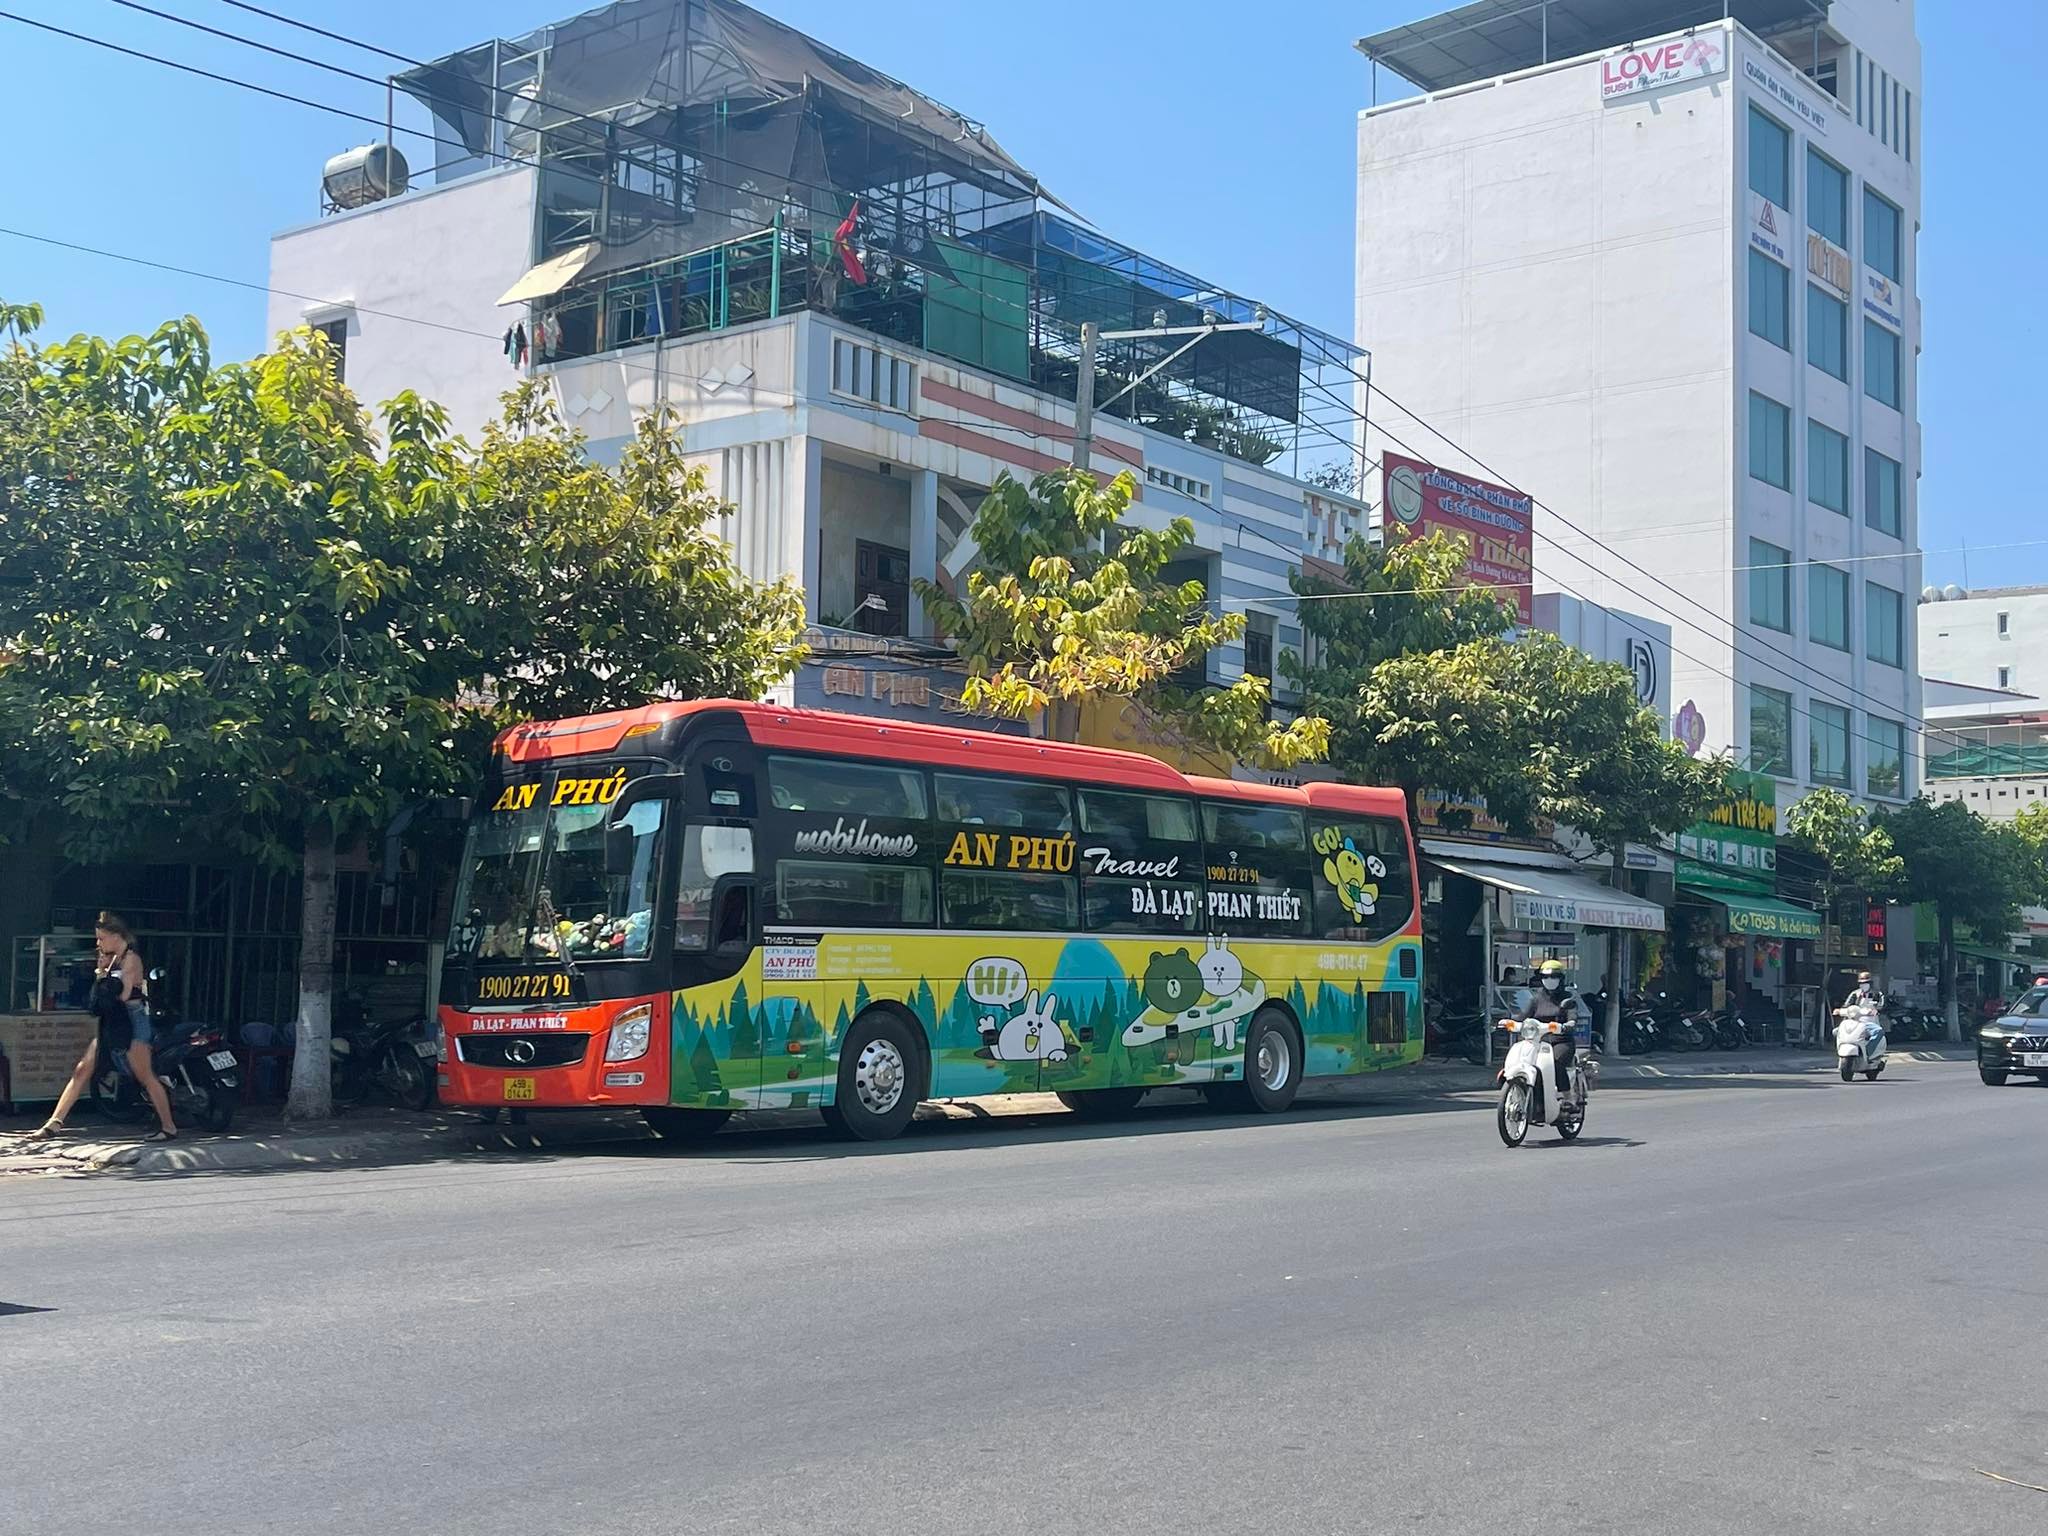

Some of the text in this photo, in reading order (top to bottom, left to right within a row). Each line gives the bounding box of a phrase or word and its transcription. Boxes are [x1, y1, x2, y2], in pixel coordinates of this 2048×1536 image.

[1603, 43, 1684, 85] LOVE
[1604, 80, 1633, 95] SUSHI
[491, 767, 627, 811] AN PHÚ
[795, 816, 918, 858] mobihome
[944, 831, 1077, 872] AN PHÚ
[1313, 826, 1343, 855] GO!
[1083, 847, 1179, 878] Travel
[1131, 881, 1158, 914] ĐÀ
[1161, 889, 1195, 921] LẠT
[1207, 891, 1252, 919] PHAN
[1256, 887, 1301, 921] THIẾT
[1579, 908, 1615, 925] MINH
[763, 936, 794, 945] THACO
[765, 957, 785, 967] AN
[787, 954, 816, 968] PHÚ
[478, 974, 570, 999] 1900 27 27 91
[974, 965, 1020, 999] HI!
[473, 1015, 485, 1030] ĐÀ
[487, 1018, 505, 1032] LẠT
[511, 1017, 537, 1030] PHAN
[539, 1013, 568, 1030] THIẾT
